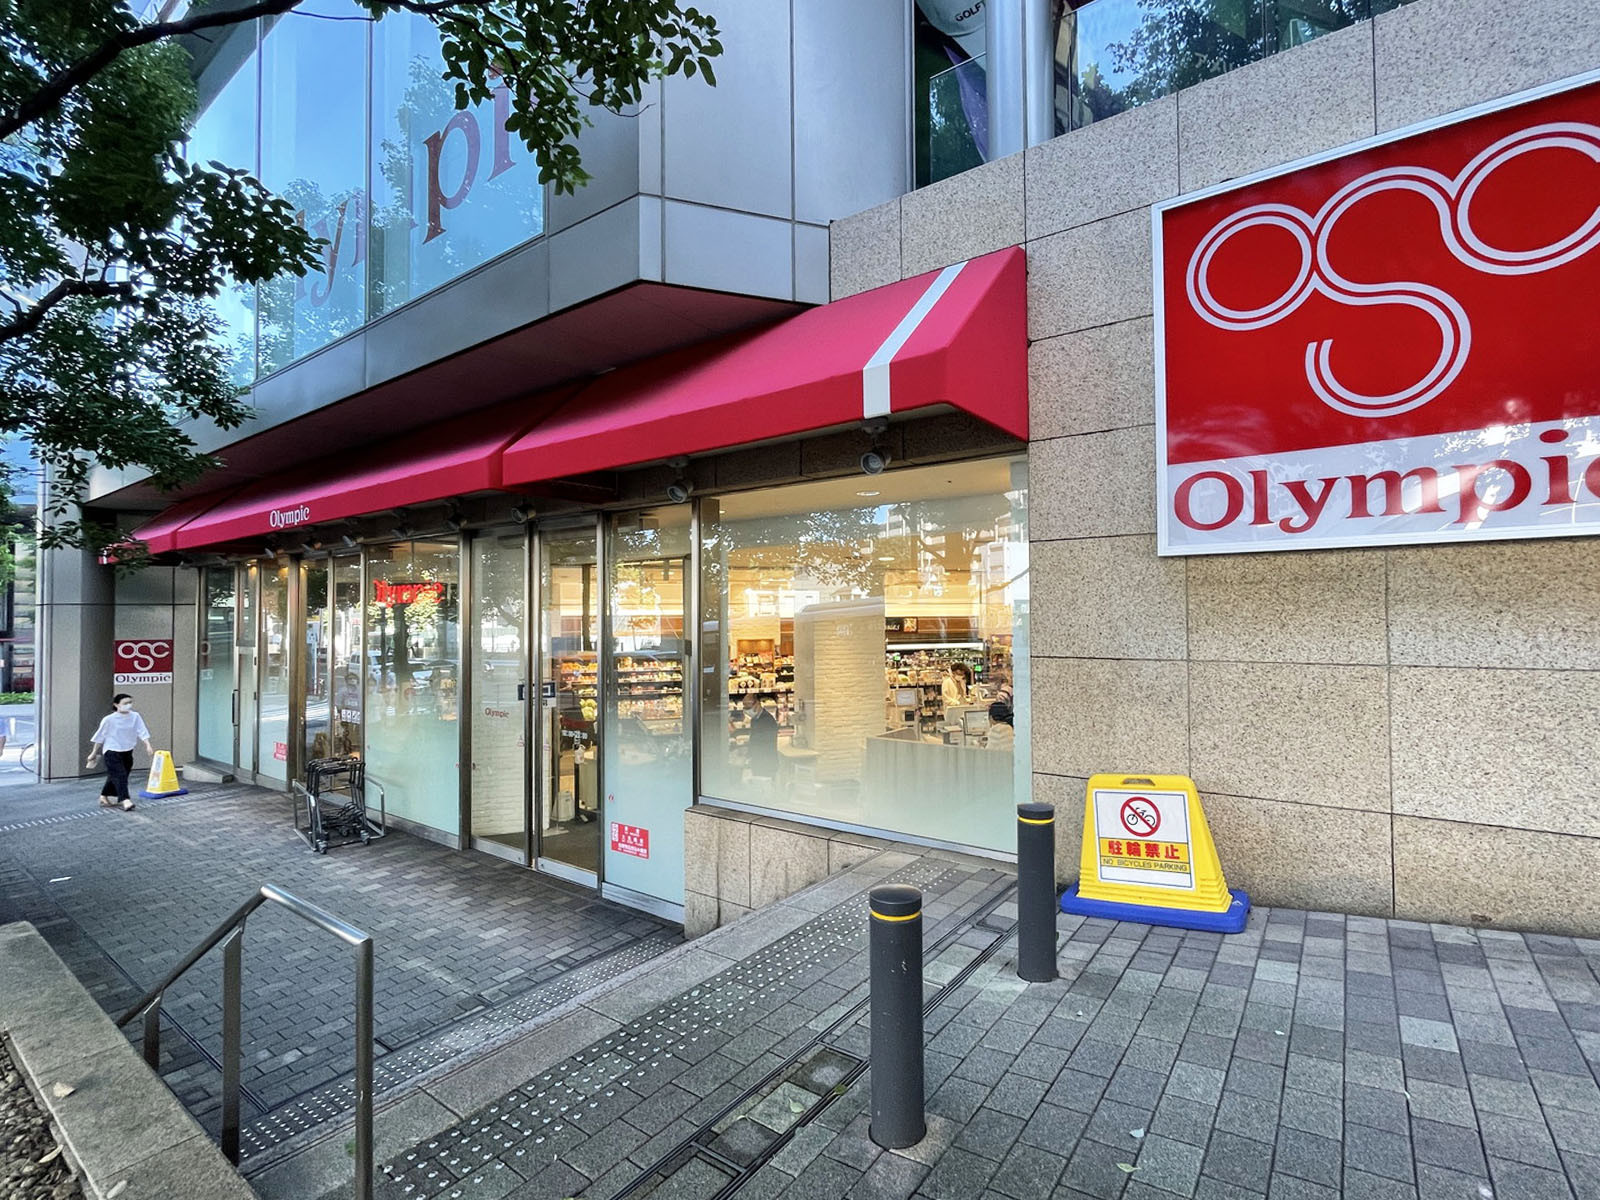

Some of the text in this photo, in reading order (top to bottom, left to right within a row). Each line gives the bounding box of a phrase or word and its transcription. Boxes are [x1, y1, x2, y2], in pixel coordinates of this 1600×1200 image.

[270, 505, 310, 528] Olympic
[116, 674, 171, 683] Olympic
[1108, 841, 1180, 860] 駐輪禁止
[1103, 858, 1188, 872] NO BICYCLES PARKING
